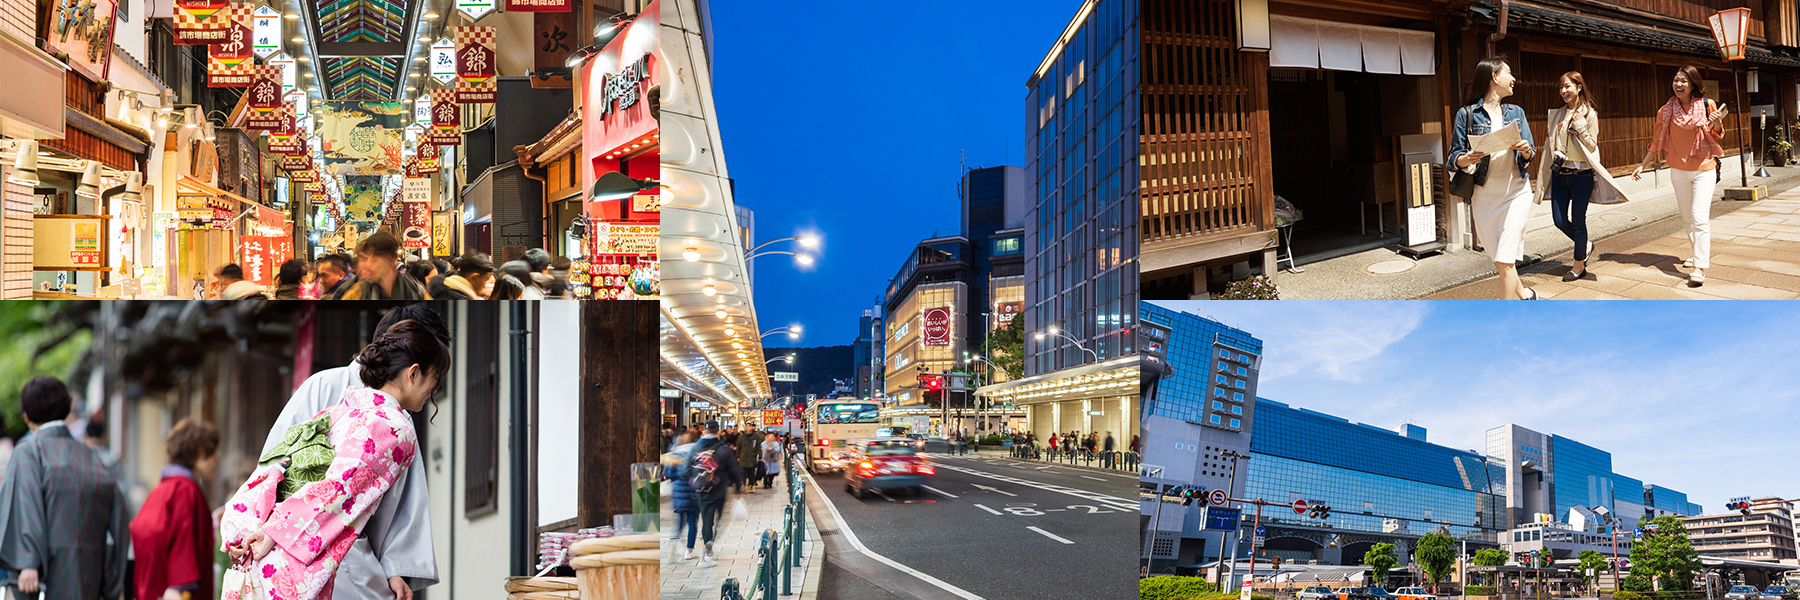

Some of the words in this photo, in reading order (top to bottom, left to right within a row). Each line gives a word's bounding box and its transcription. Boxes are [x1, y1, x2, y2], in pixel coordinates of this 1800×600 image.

[179, 30, 226, 40] 錦市場商店街
[542, 25, 570, 53] 次
[437, 52, 453, 65] 弘
[461, 45, 487, 77] 錦
[252, 80, 275, 108] 錦
[434, 103, 455, 126] 錦
[414, 203, 426, 225] 喫茶
